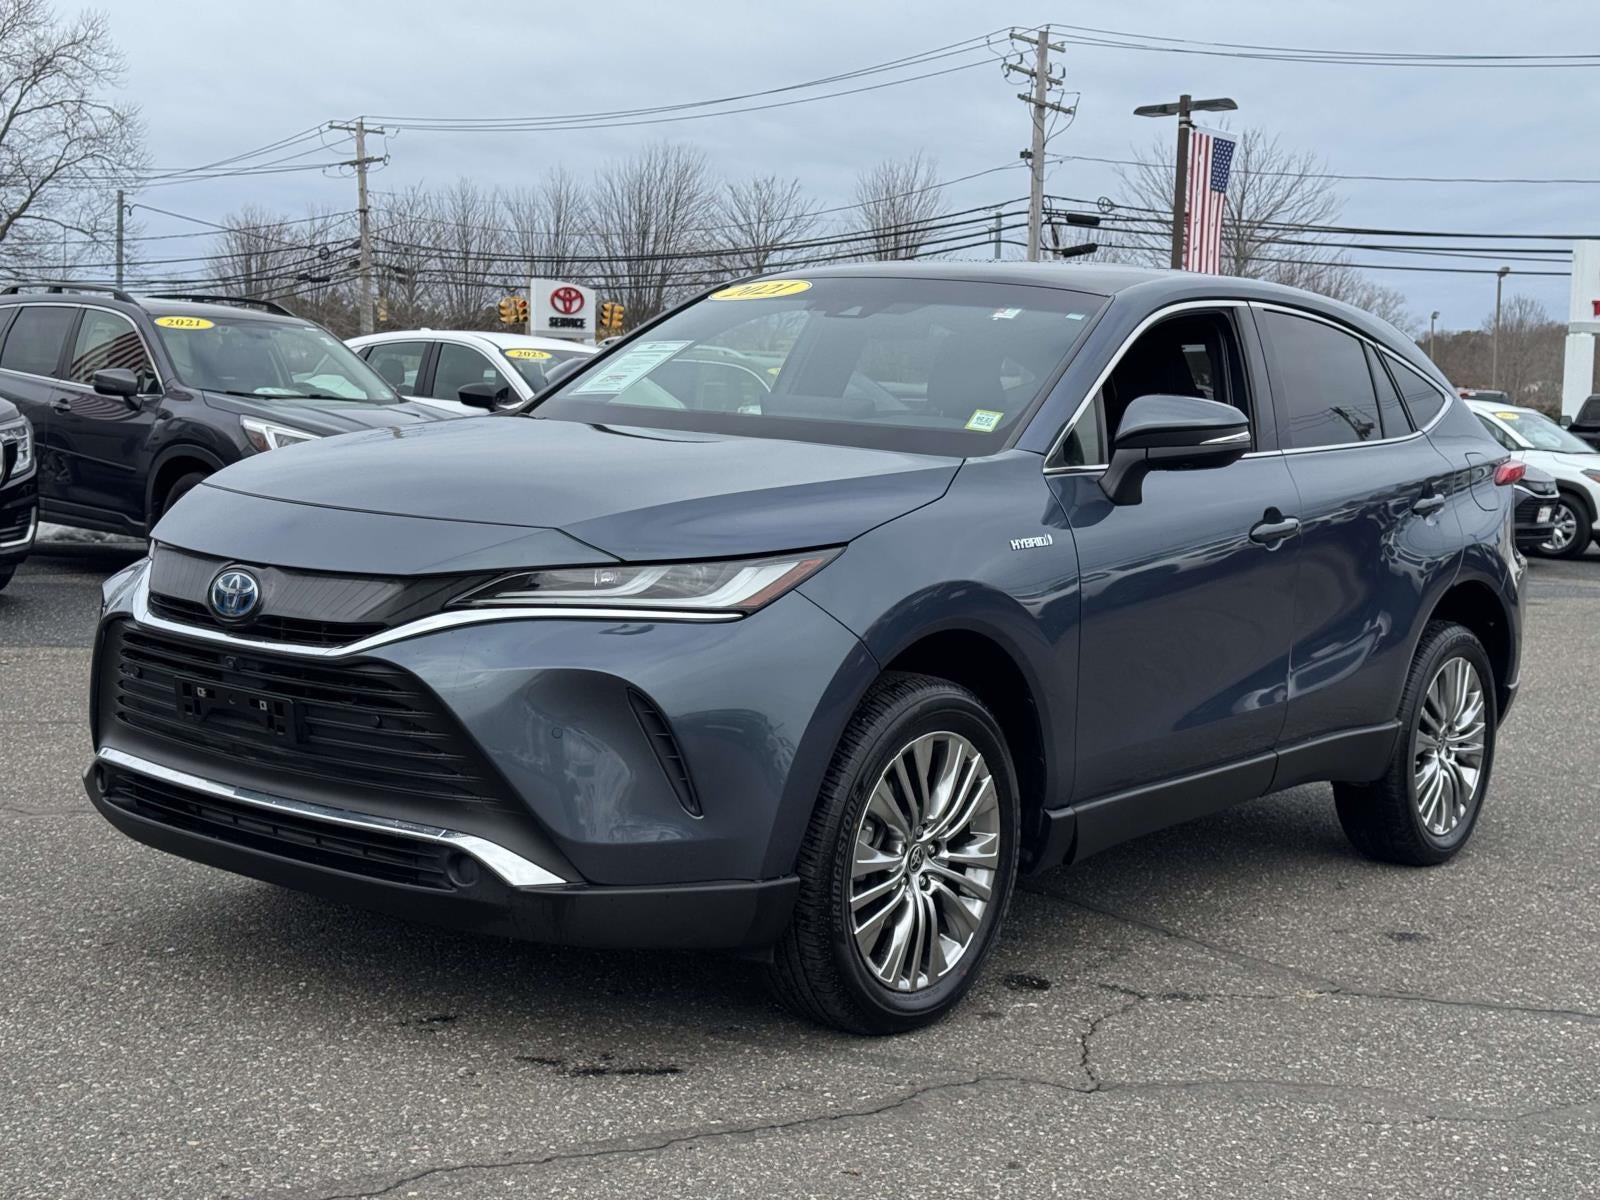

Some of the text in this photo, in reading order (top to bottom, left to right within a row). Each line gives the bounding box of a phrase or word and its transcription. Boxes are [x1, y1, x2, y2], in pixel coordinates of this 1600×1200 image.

[166, 318, 201, 327] 2021
[548, 317, 586, 328] SERVICE
[1010, 536, 1049, 550] HYBRID
[831, 788, 862, 933] BRIDGESTONE
